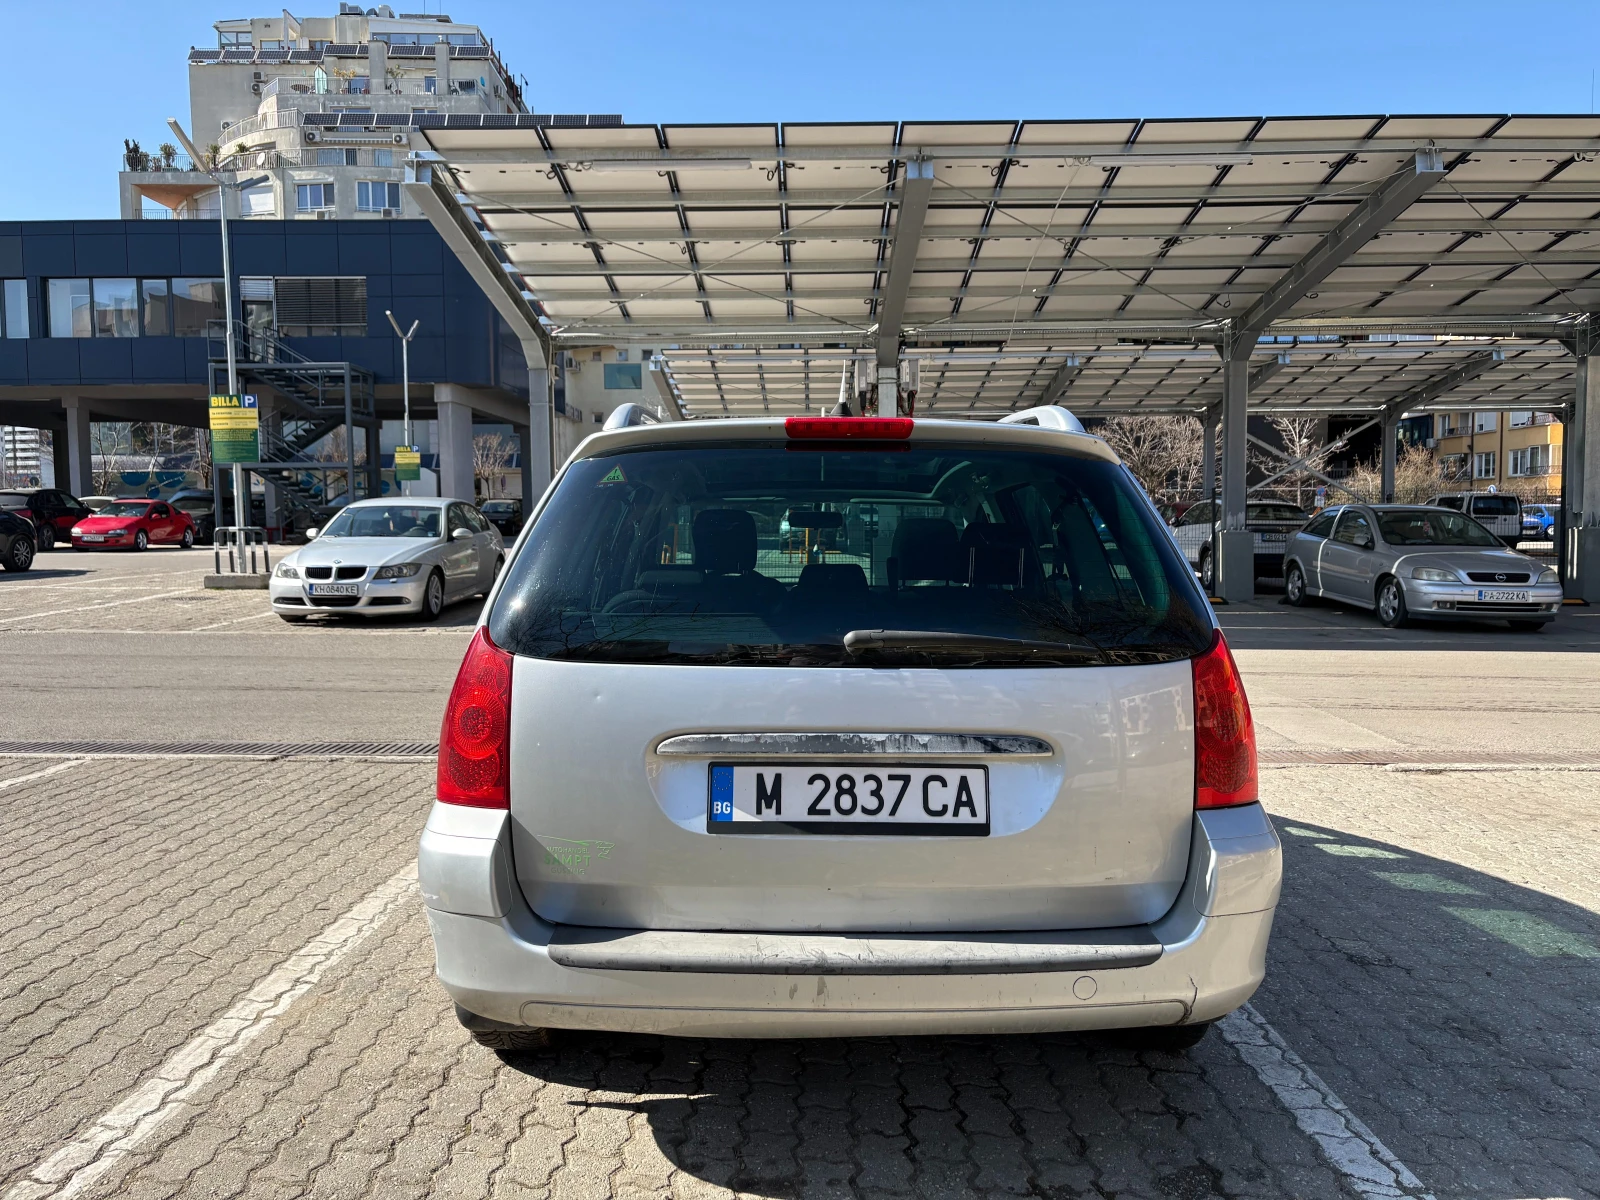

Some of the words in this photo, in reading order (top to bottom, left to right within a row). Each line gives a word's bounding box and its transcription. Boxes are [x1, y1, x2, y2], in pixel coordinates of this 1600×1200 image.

[210, 396, 239, 407] BILLA
[244, 395, 254, 407] P
[755, 773, 782, 815] M
[807, 773, 911, 816] 2837
[922, 775, 978, 818] CA
[713, 801, 731, 814] BG
[546, 846, 590, 854] AUTOHANDEL
[544, 853, 592, 867] SAMPT
